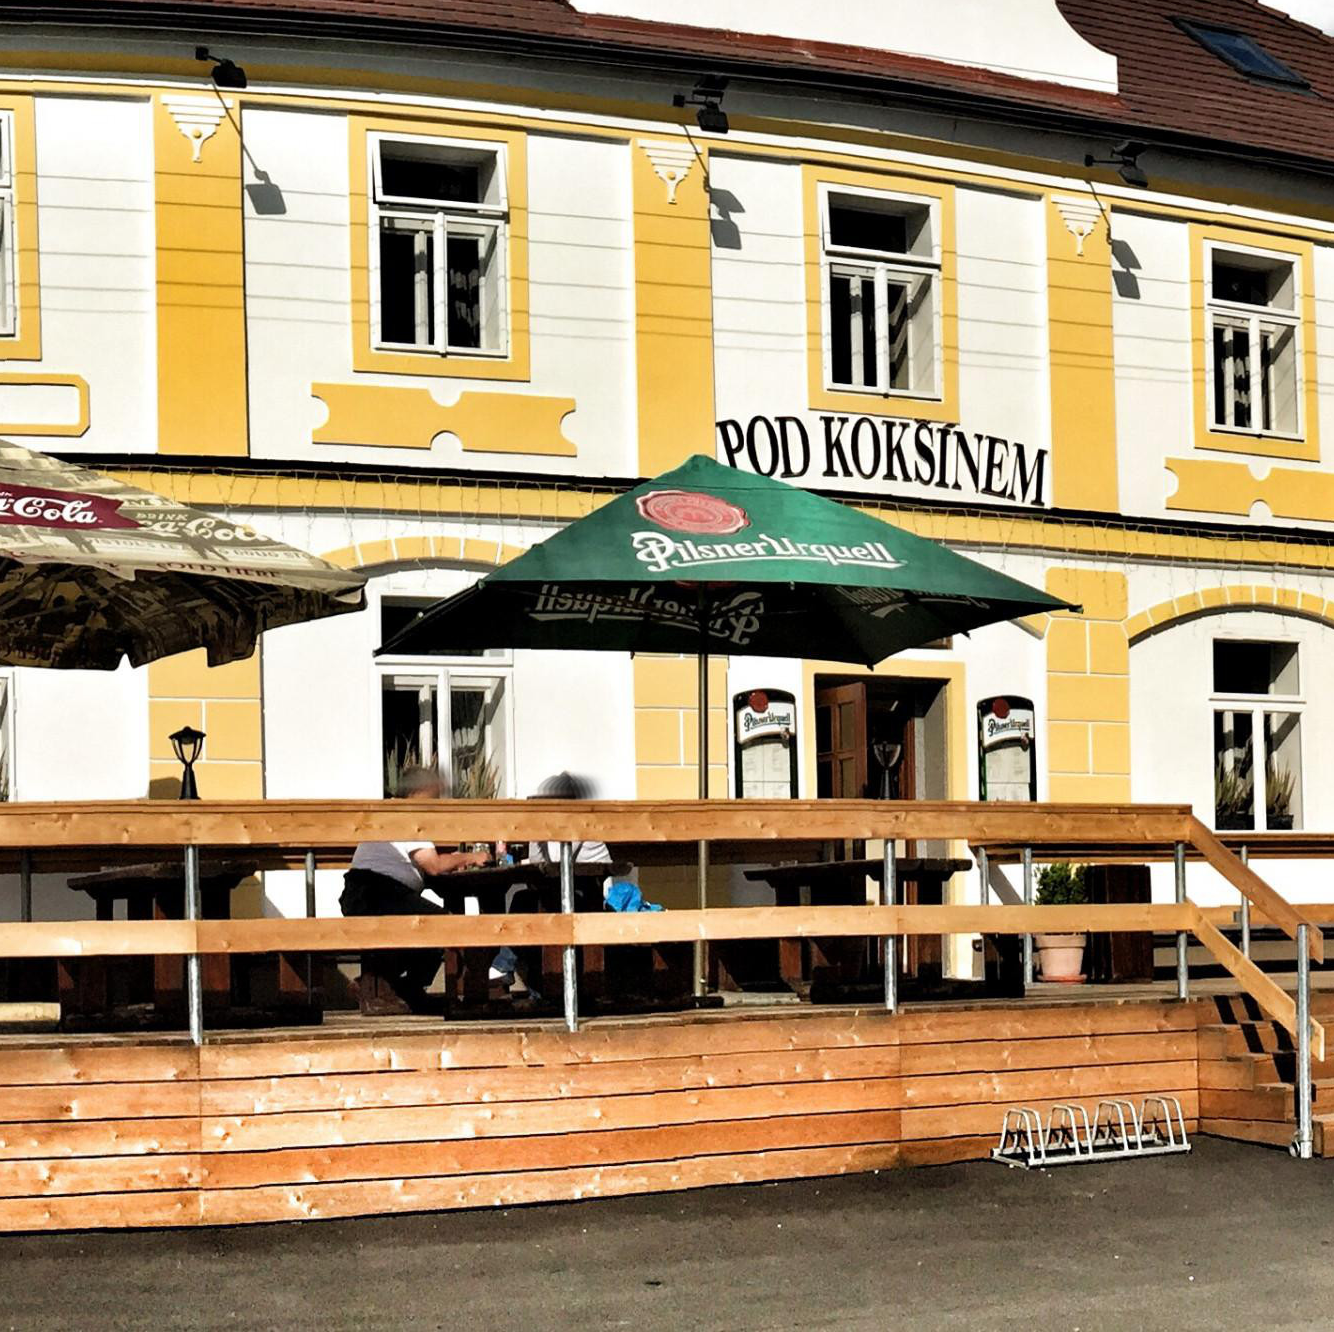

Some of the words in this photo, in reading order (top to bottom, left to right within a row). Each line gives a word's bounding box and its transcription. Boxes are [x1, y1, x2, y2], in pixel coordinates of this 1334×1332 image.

[715, 415, 811, 479] POD
[820, 416, 1049, 507] KOKŠÍNEM
[630, 531, 768, 572] Pilsner
[758, 533, 896, 566] Urquell
